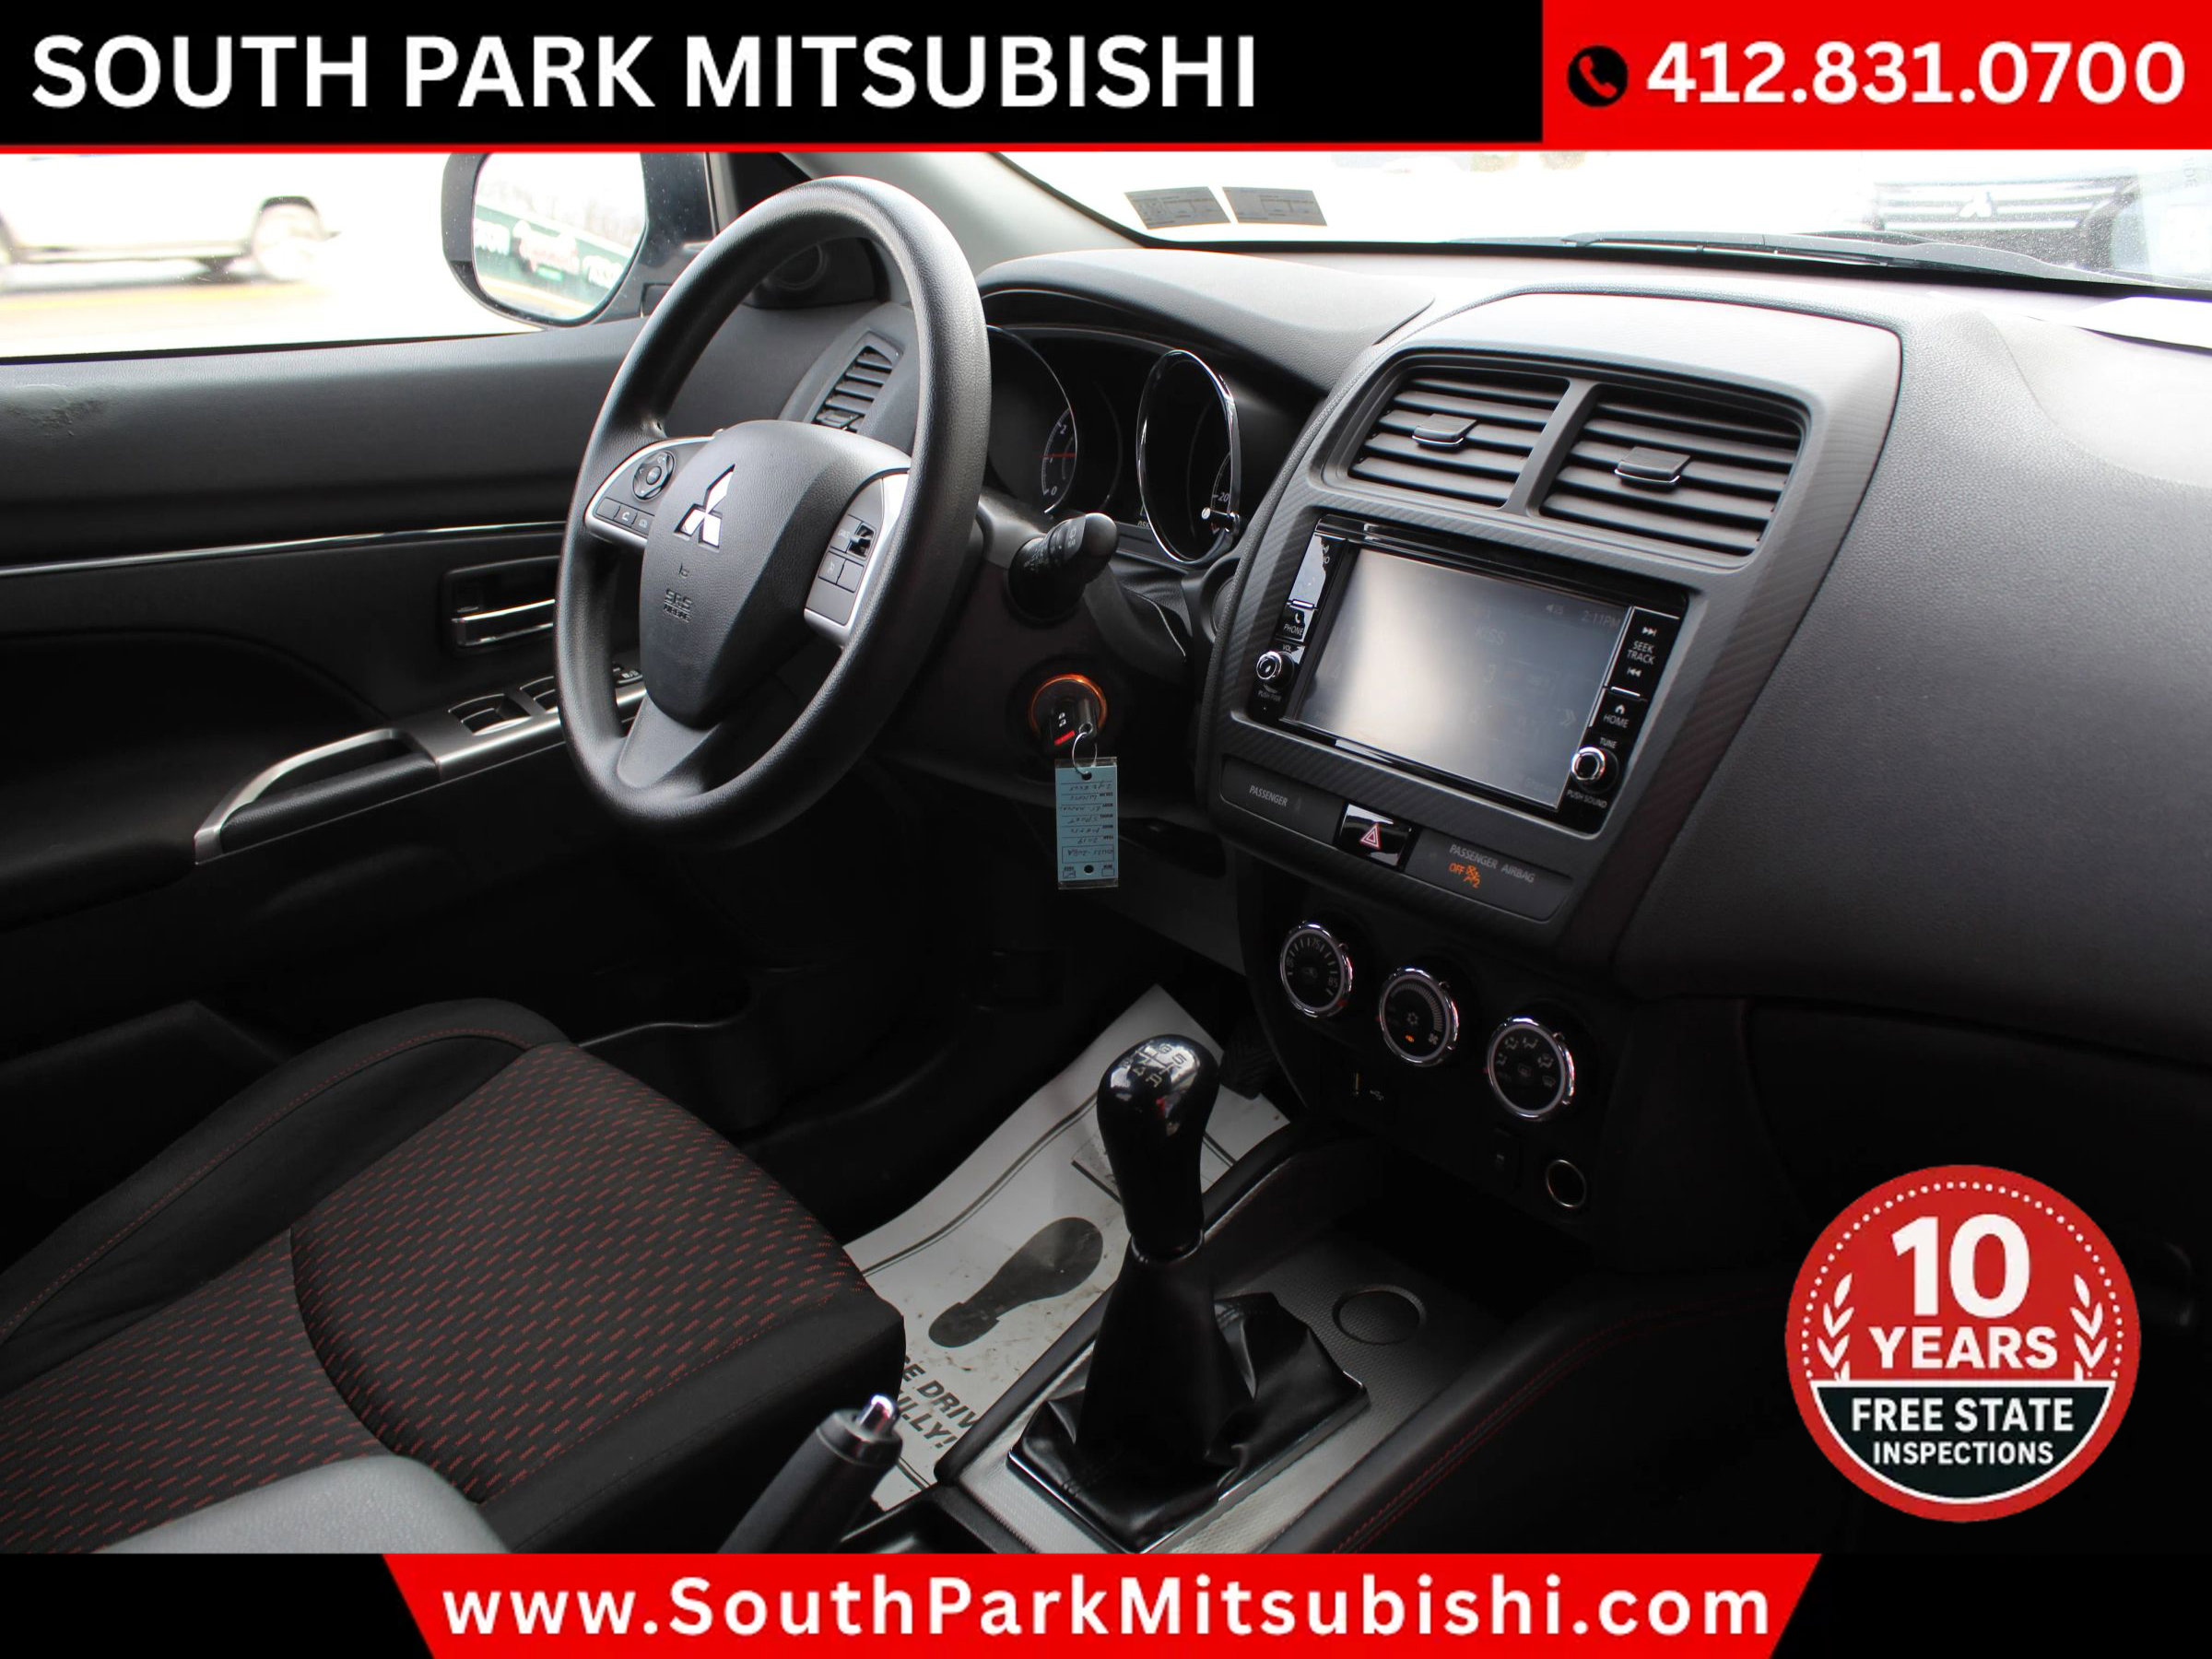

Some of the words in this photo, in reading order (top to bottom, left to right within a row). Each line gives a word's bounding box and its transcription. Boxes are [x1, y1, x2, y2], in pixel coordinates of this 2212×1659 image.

[1283, 624, 1304, 636] PHONE
[1632, 640, 1655, 653] SEEK
[1626, 649, 1655, 665] TRACK
[1603, 713, 1630, 729] HOME
[1599, 737, 1618, 749] TUNE
[1249, 785, 1288, 807] PASSENGER
[1449, 843, 1499, 869] PASSENGER
[1500, 864, 1535, 884] AIRBAG
[1449, 863, 1465, 875] OFF
[916, 1380, 981, 1429] DRIV
